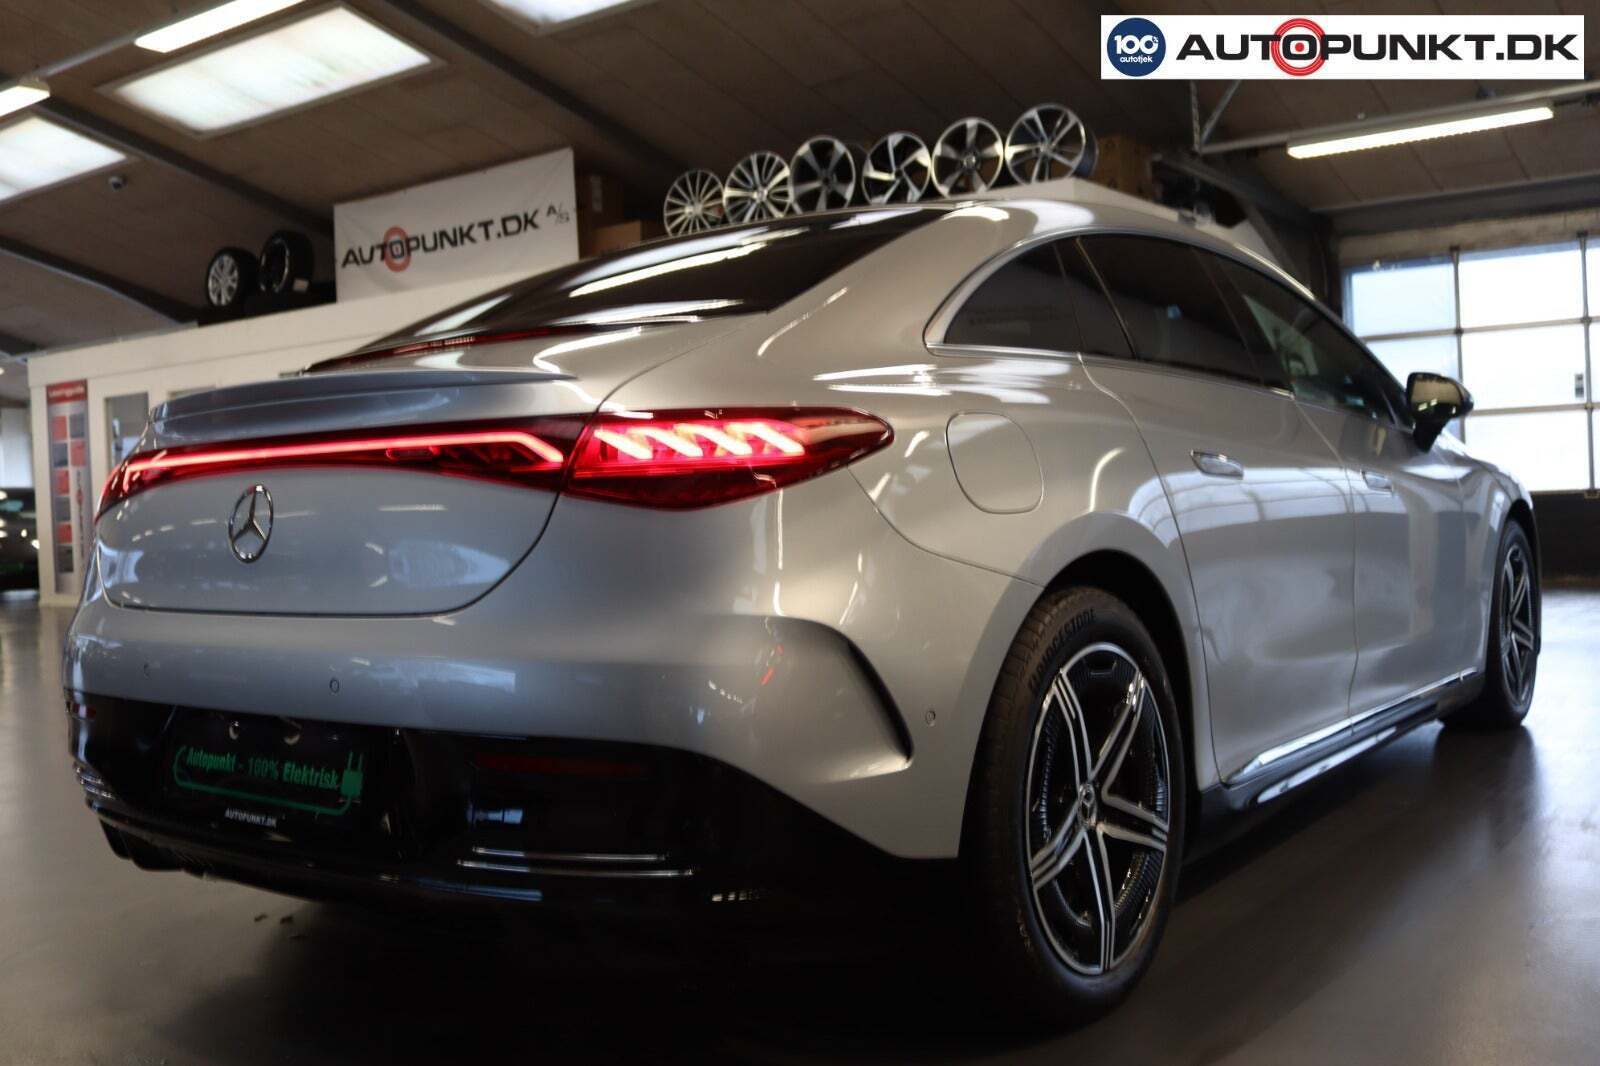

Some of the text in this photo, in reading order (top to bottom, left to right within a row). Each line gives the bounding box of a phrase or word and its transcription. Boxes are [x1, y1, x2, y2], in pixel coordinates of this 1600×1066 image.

[341, 208, 540, 269] AUTOPUNKT.DK
[187, 748, 236, 772] Autopunkt
[249, 757, 279, 781] 100%
[283, 762, 339, 790] Elektrisk
[225, 808, 277, 828] AUTOPUNKT.DK
